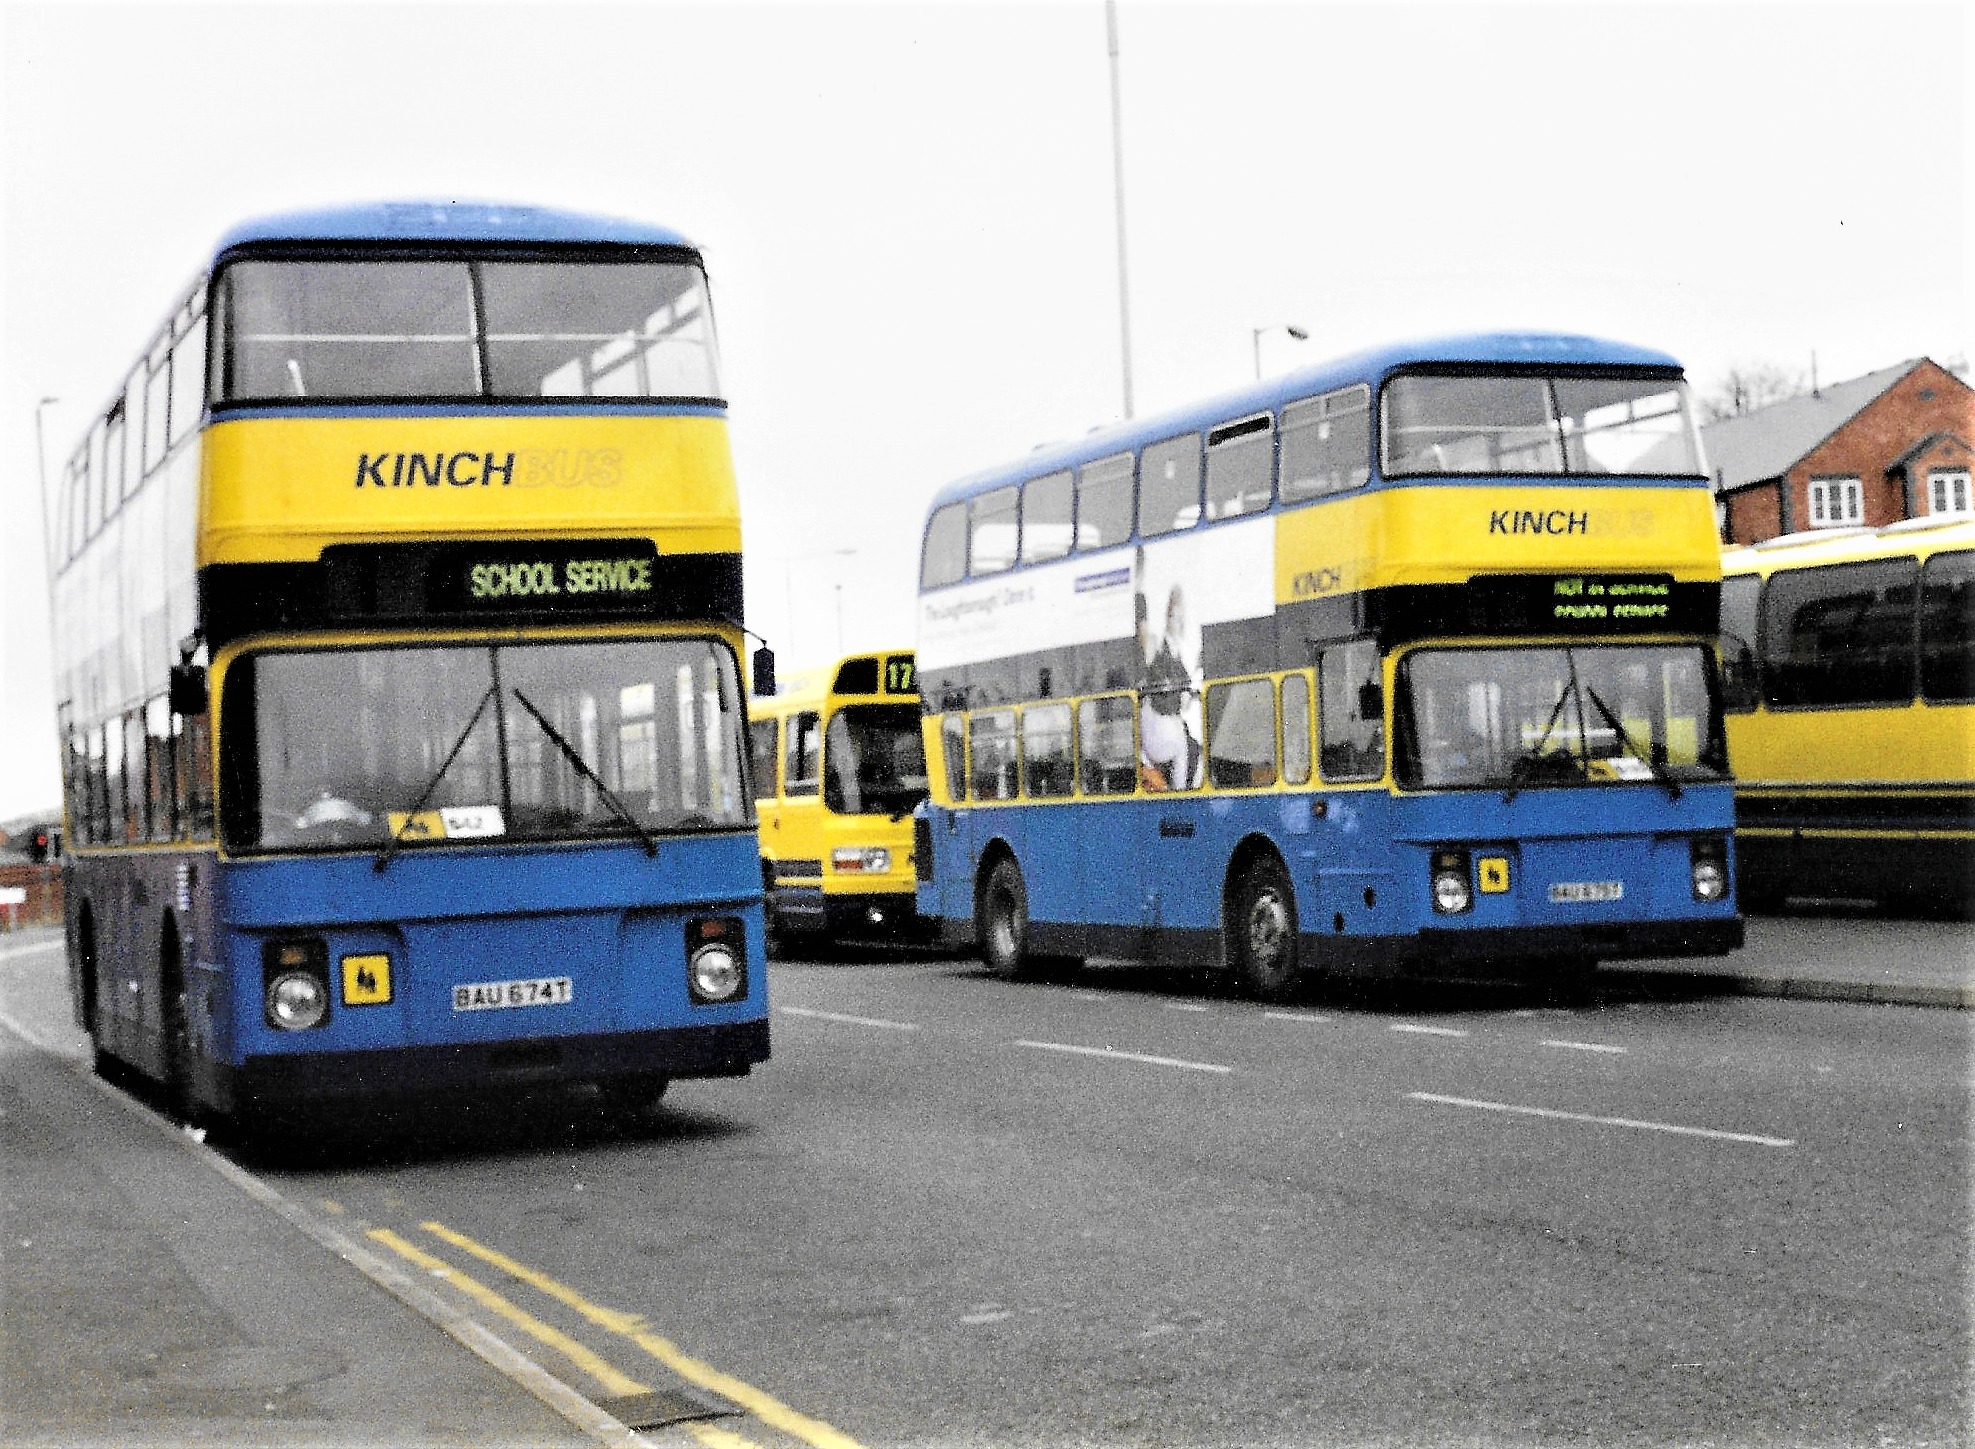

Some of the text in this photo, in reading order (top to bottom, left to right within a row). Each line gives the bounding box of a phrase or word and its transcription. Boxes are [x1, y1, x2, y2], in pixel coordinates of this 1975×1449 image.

[470, 559, 652, 598] SCHOOL SERVICE
[888, 661, 912, 690] 17
